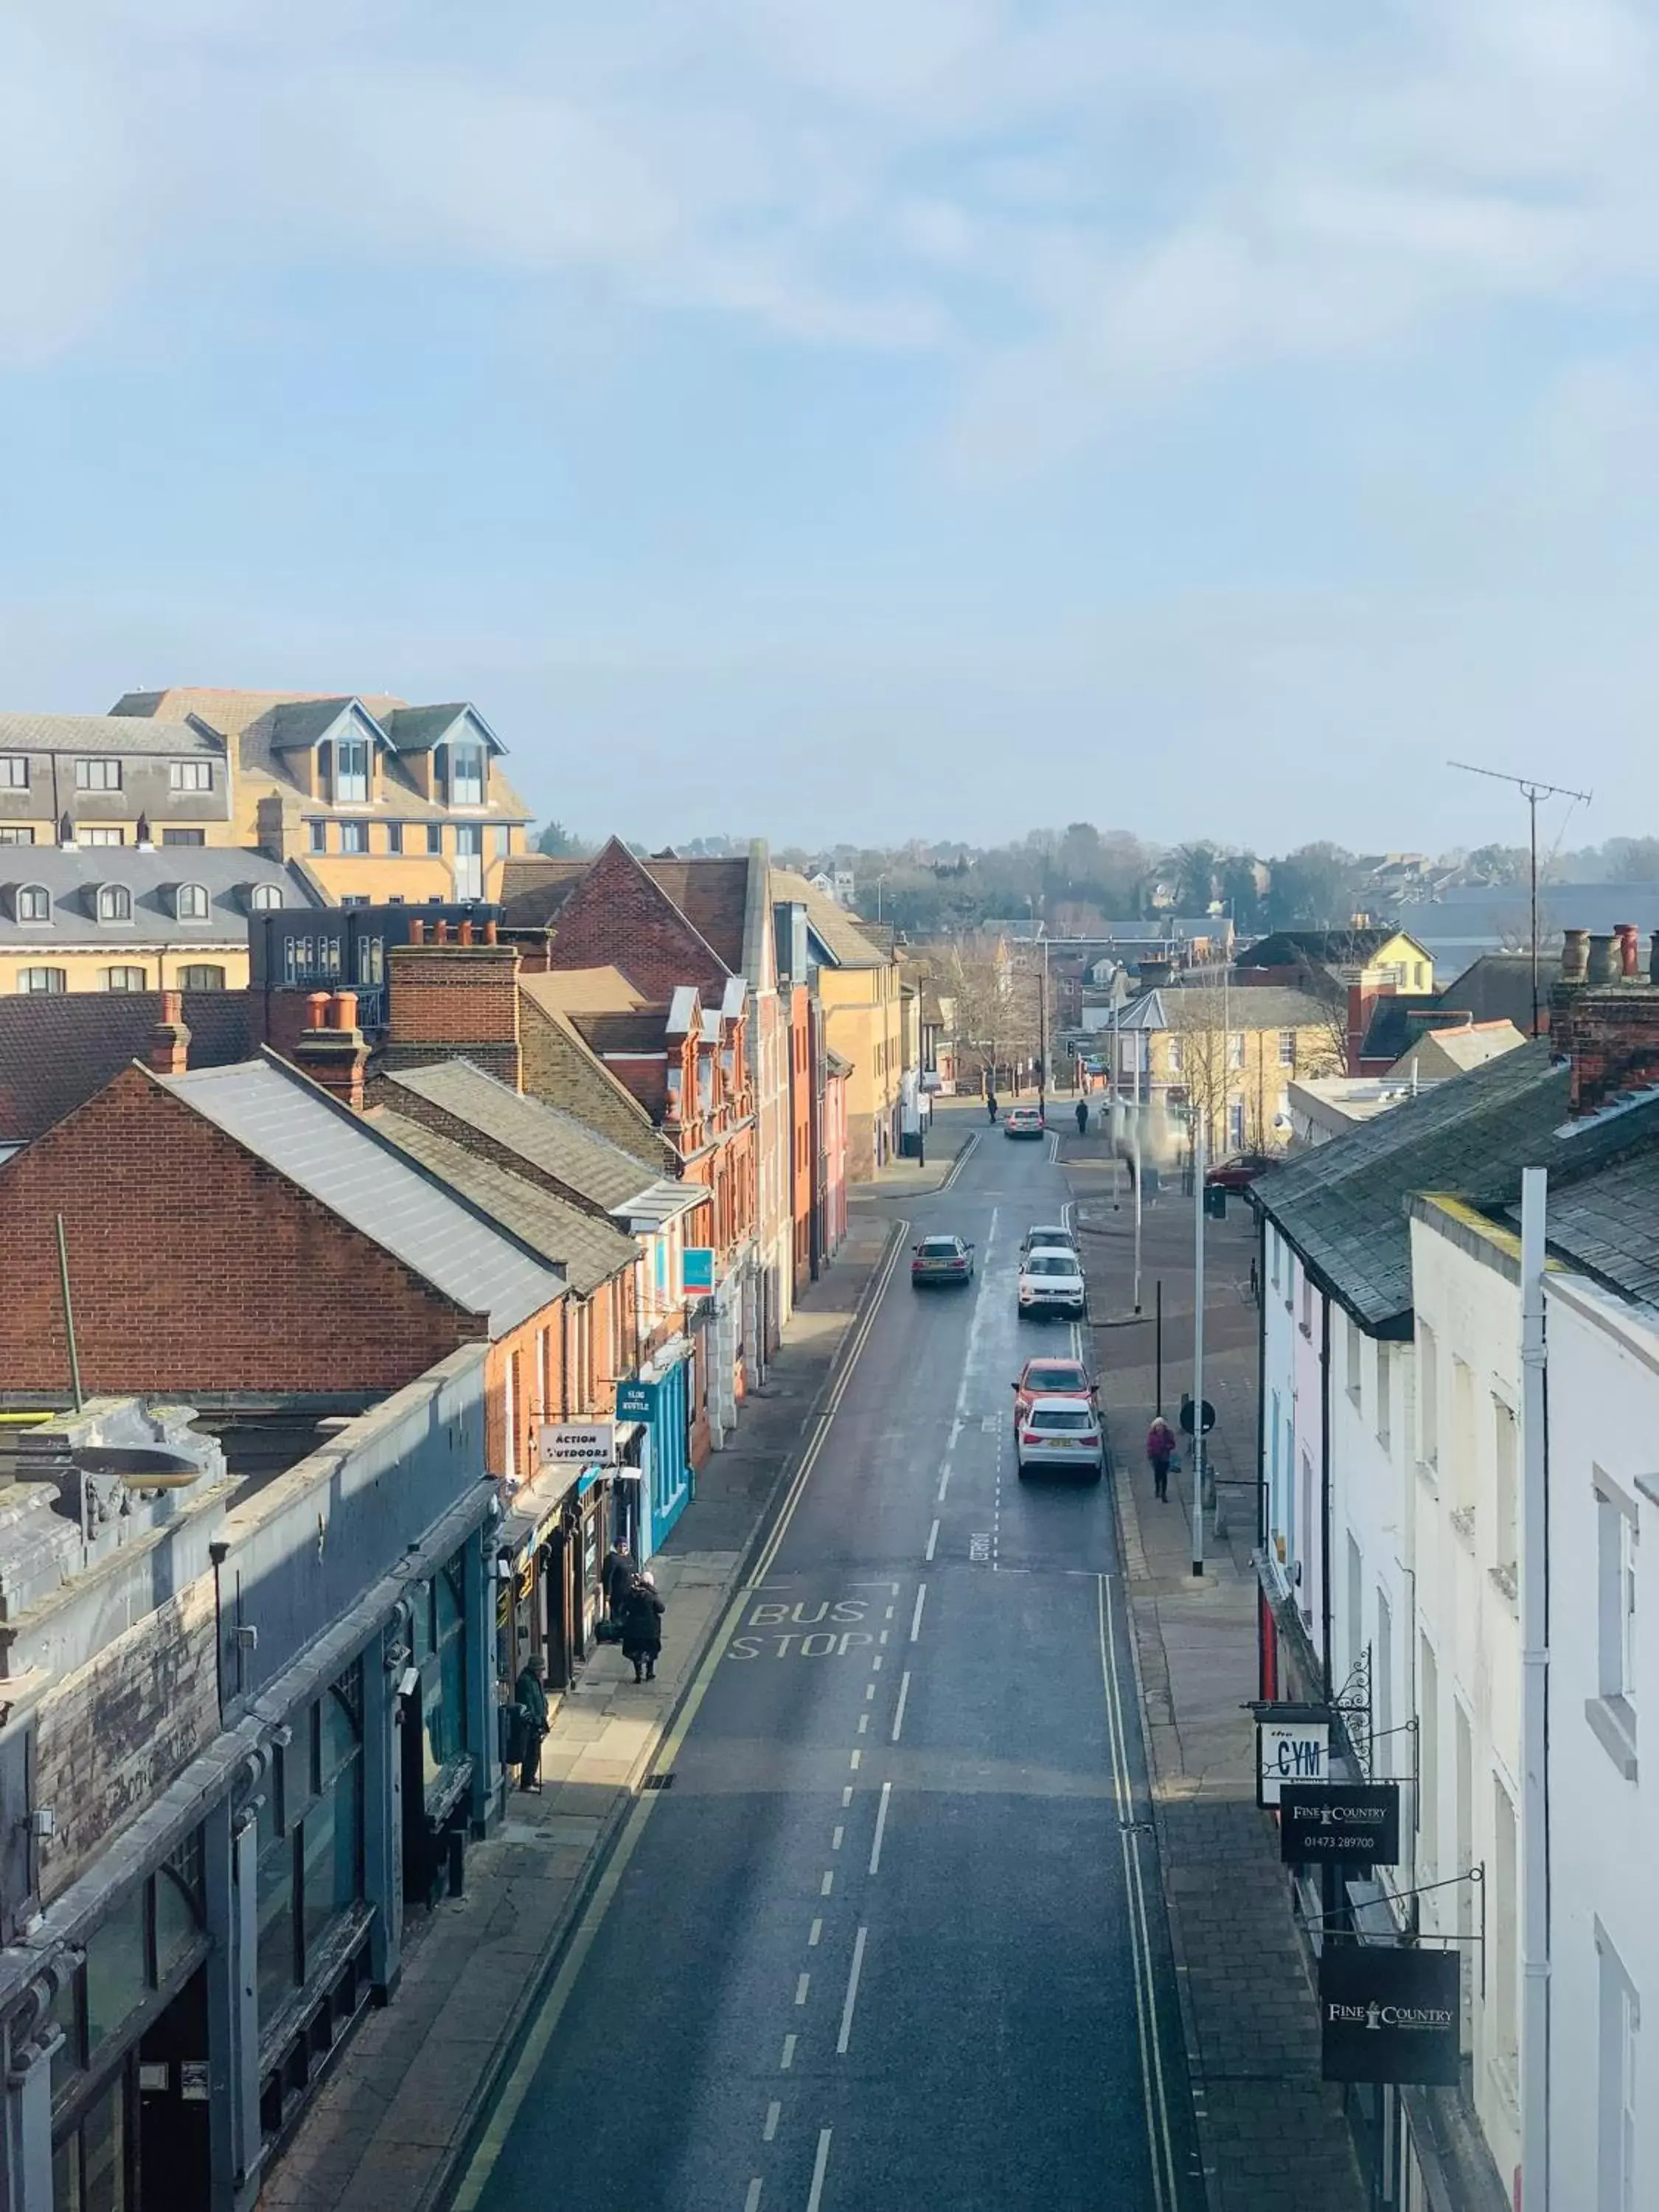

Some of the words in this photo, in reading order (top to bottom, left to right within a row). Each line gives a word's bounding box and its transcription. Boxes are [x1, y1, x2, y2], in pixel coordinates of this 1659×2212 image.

[556, 1433, 597, 1444] ACTION
[748, 1601, 869, 1626] BUS
[728, 1632, 874, 1660] STOP
[1293, 1806, 1321, 1819] FINE
[1332, 1806, 1388, 1820] COUNTRY
[1304, 1837, 1335, 1847] 01473
[1338, 1837, 1374, 1848] 289700
[1328, 2003, 1365, 2021] FINE
[1381, 2006, 1454, 2024] COUNTRY
